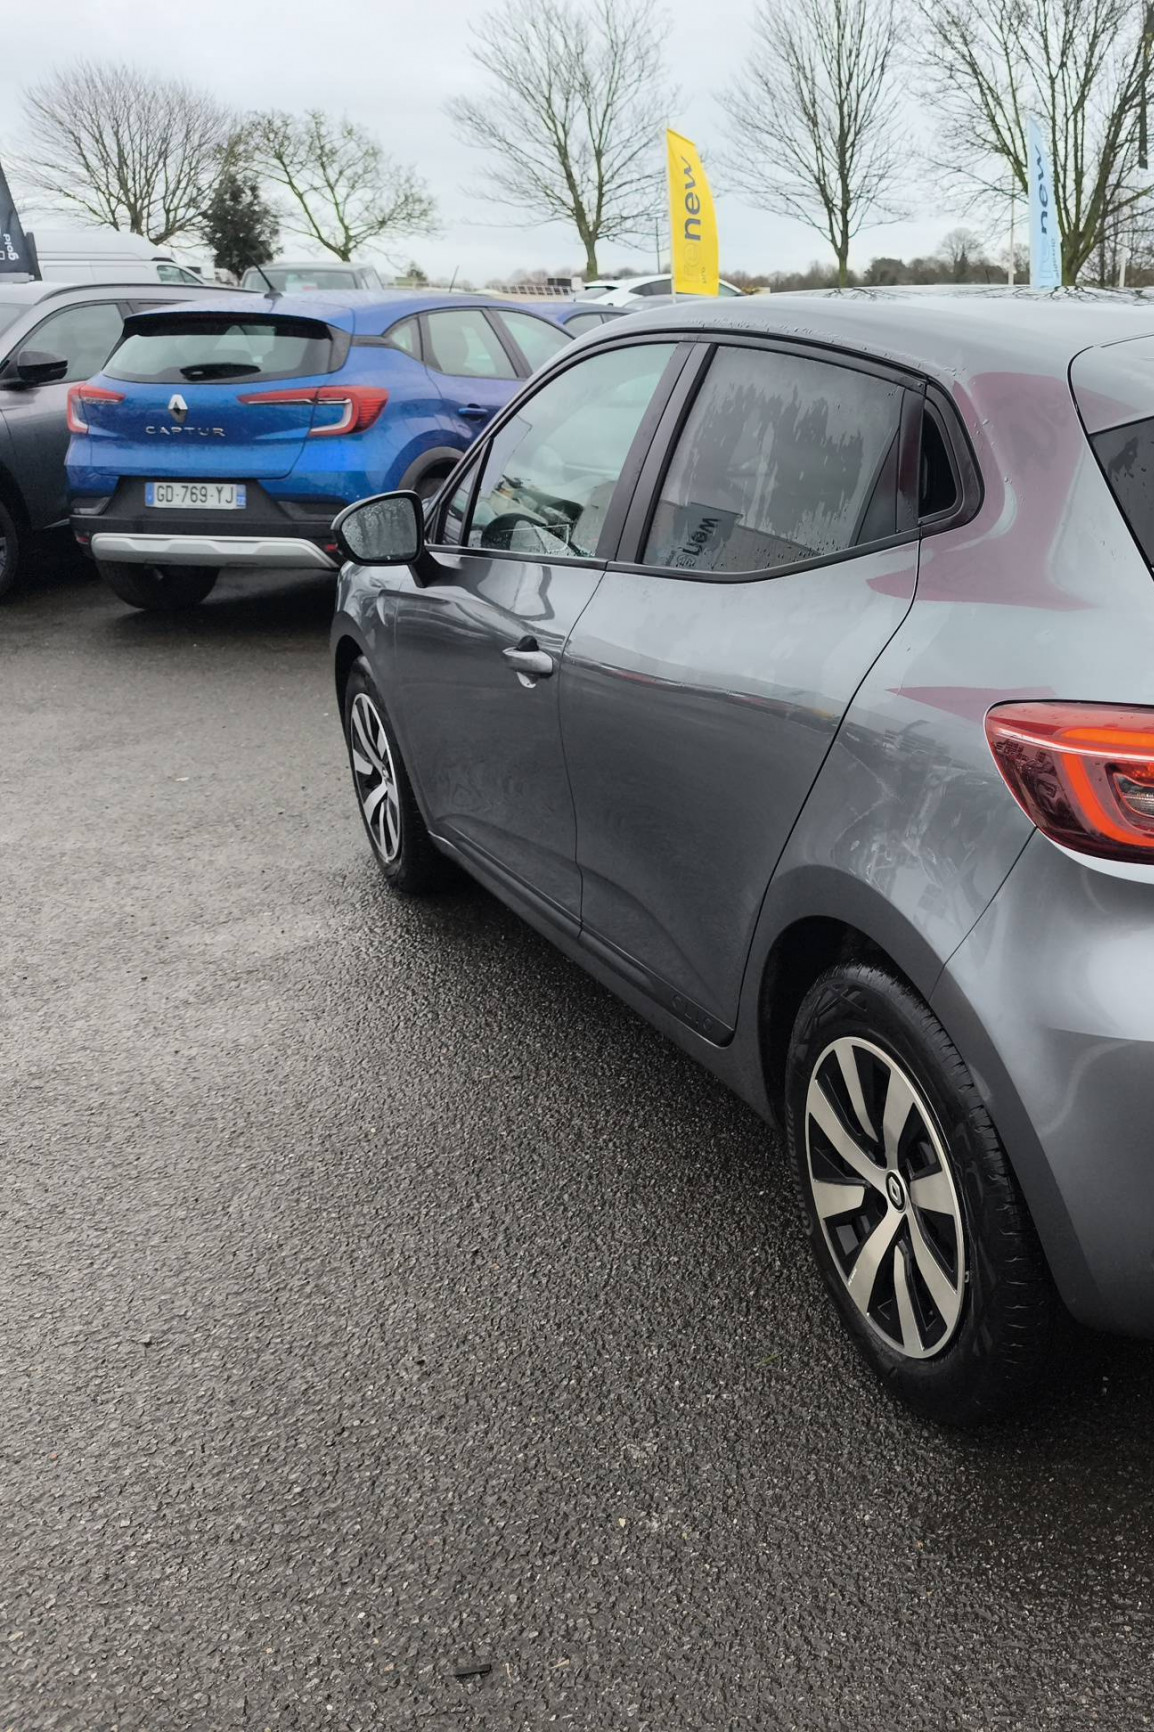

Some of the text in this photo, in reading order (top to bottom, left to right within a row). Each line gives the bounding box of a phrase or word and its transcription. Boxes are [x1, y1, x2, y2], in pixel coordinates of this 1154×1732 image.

[3, 233, 19, 261] gold
[145, 425, 226, 437] CAPTUR
[156, 485, 234, 504] GD-769-YJ
